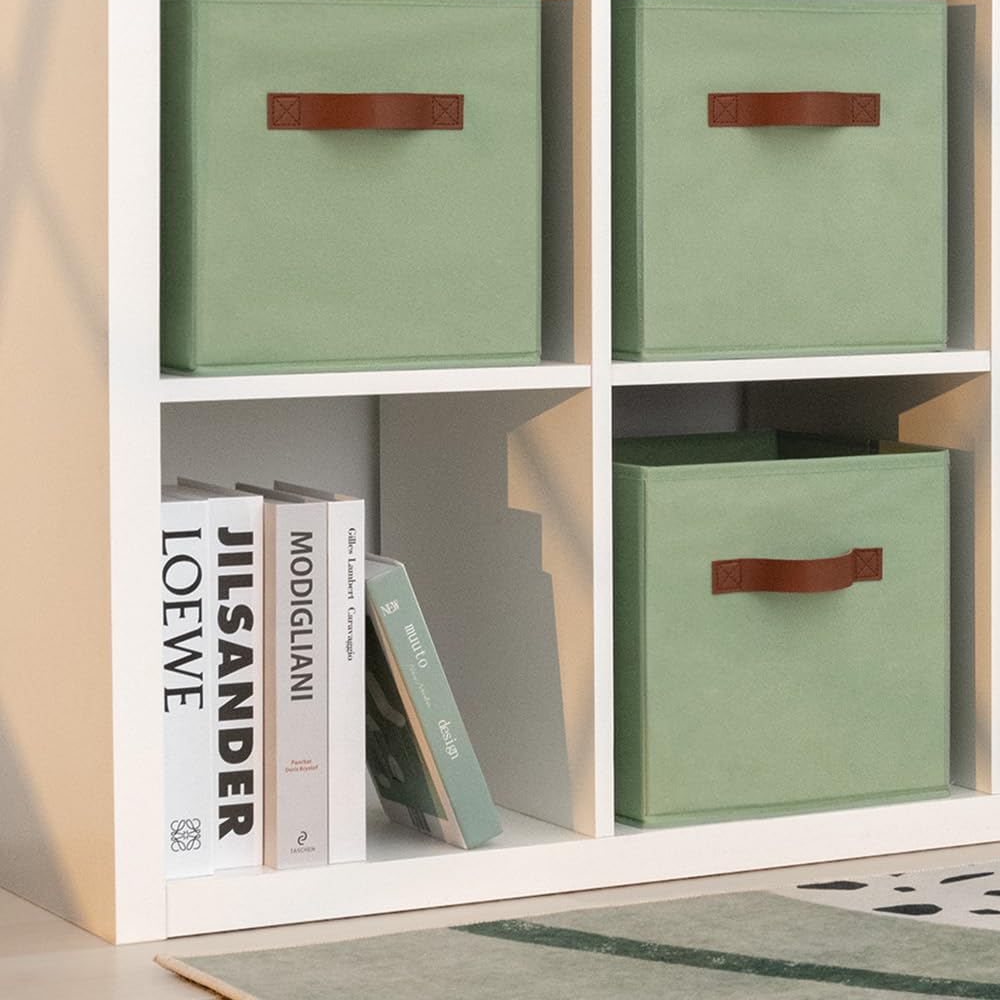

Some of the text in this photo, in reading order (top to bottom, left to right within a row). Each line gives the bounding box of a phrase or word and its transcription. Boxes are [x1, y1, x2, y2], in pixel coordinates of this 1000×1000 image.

[162, 527, 204, 713] LOEWE
[290, 531, 314, 702] MODIGLIANI
[345, 527, 357, 662] Gilles Lambert Caravaggio
[404, 623, 428, 669] muuto
[438, 719, 460, 761] design
[290, 846, 316, 855] TASCHEN
